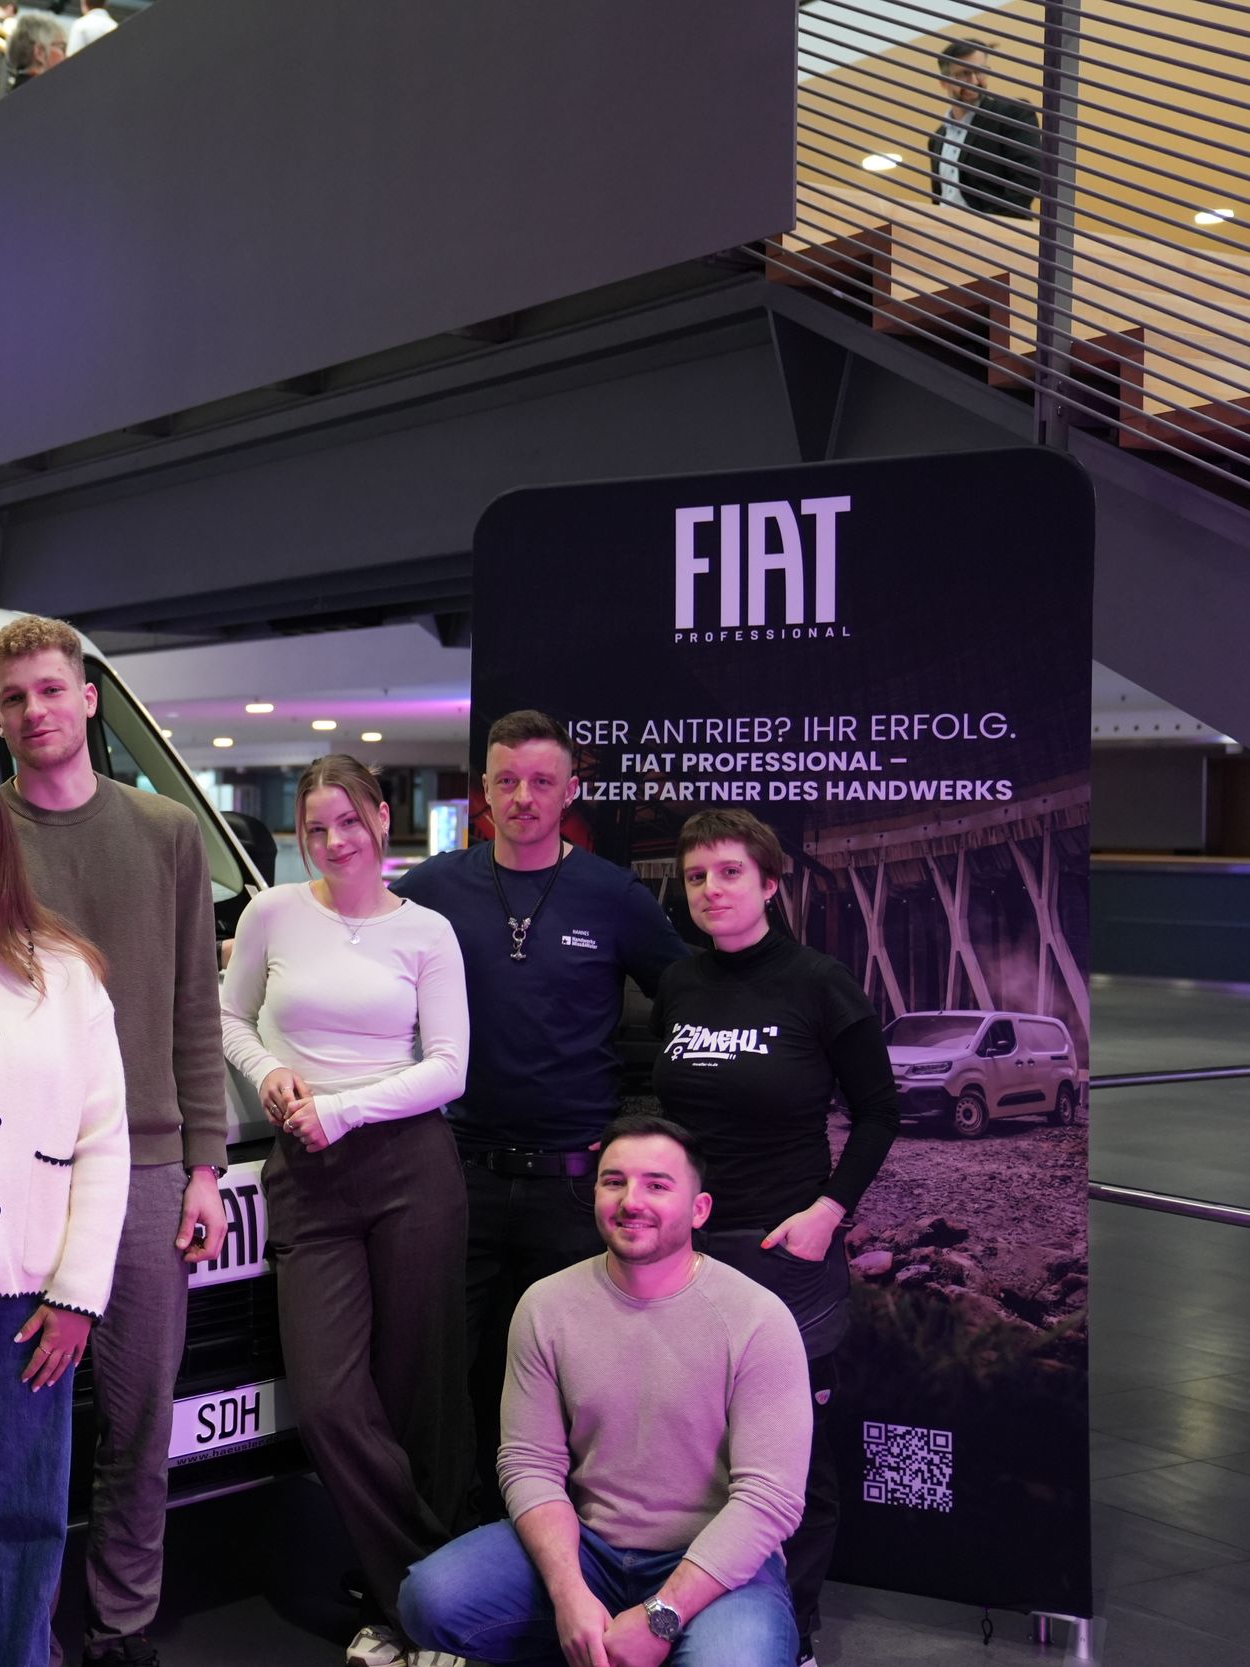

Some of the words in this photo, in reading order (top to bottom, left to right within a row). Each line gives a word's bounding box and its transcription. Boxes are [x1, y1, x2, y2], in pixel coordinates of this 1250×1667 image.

[674, 495, 852, 630] FIAT
[674, 625, 852, 644] PROFESSIONAL
[640, 716, 792, 744] ANTRIEB?
[804, 715, 858, 743] IHR
[871, 712, 1017, 742] ERFOLG.
[621, 753, 676, 773] FIAT
[682, 751, 882, 773] PROFESSIONAL
[644, 781, 764, 801] PARTNER
[769, 780, 819, 801] DES
[825, 779, 1013, 801] HANDWERKS
[196, 1391, 261, 1444] SDH
